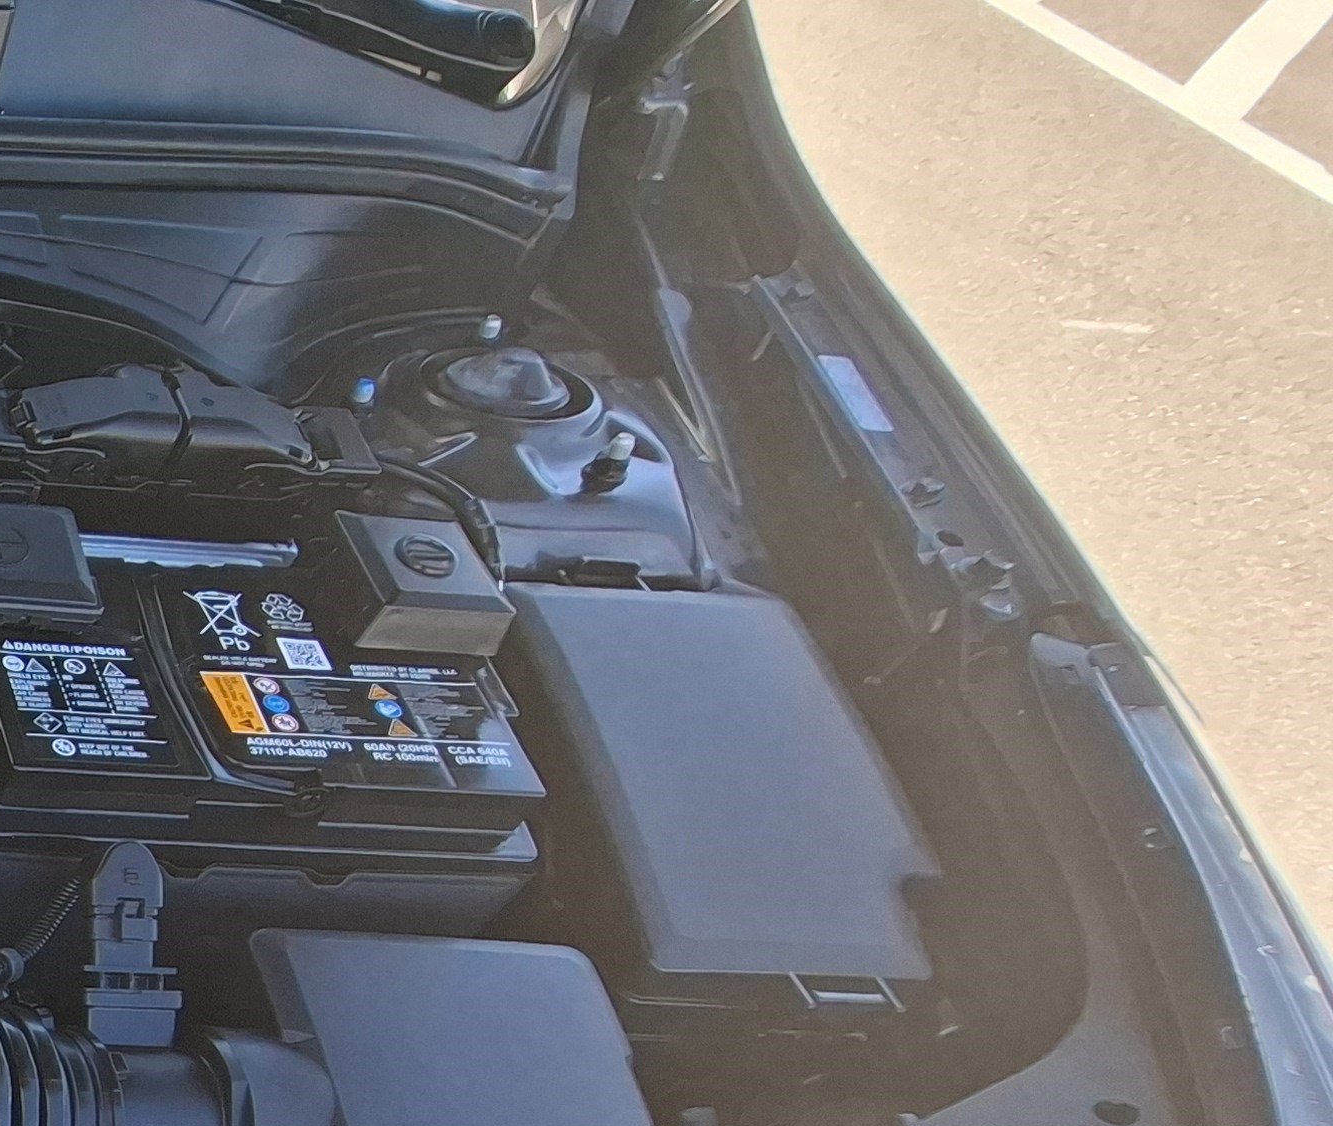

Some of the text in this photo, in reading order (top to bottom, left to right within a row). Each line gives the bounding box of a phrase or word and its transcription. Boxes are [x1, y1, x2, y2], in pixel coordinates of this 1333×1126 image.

[13, 641, 127, 657] DANGER/POISON
[219, 636, 251, 651] Pb
[363, 742, 396, 752] 60Ah
[446, 745, 476, 756] CCA
[372, 751, 393, 761] RC
